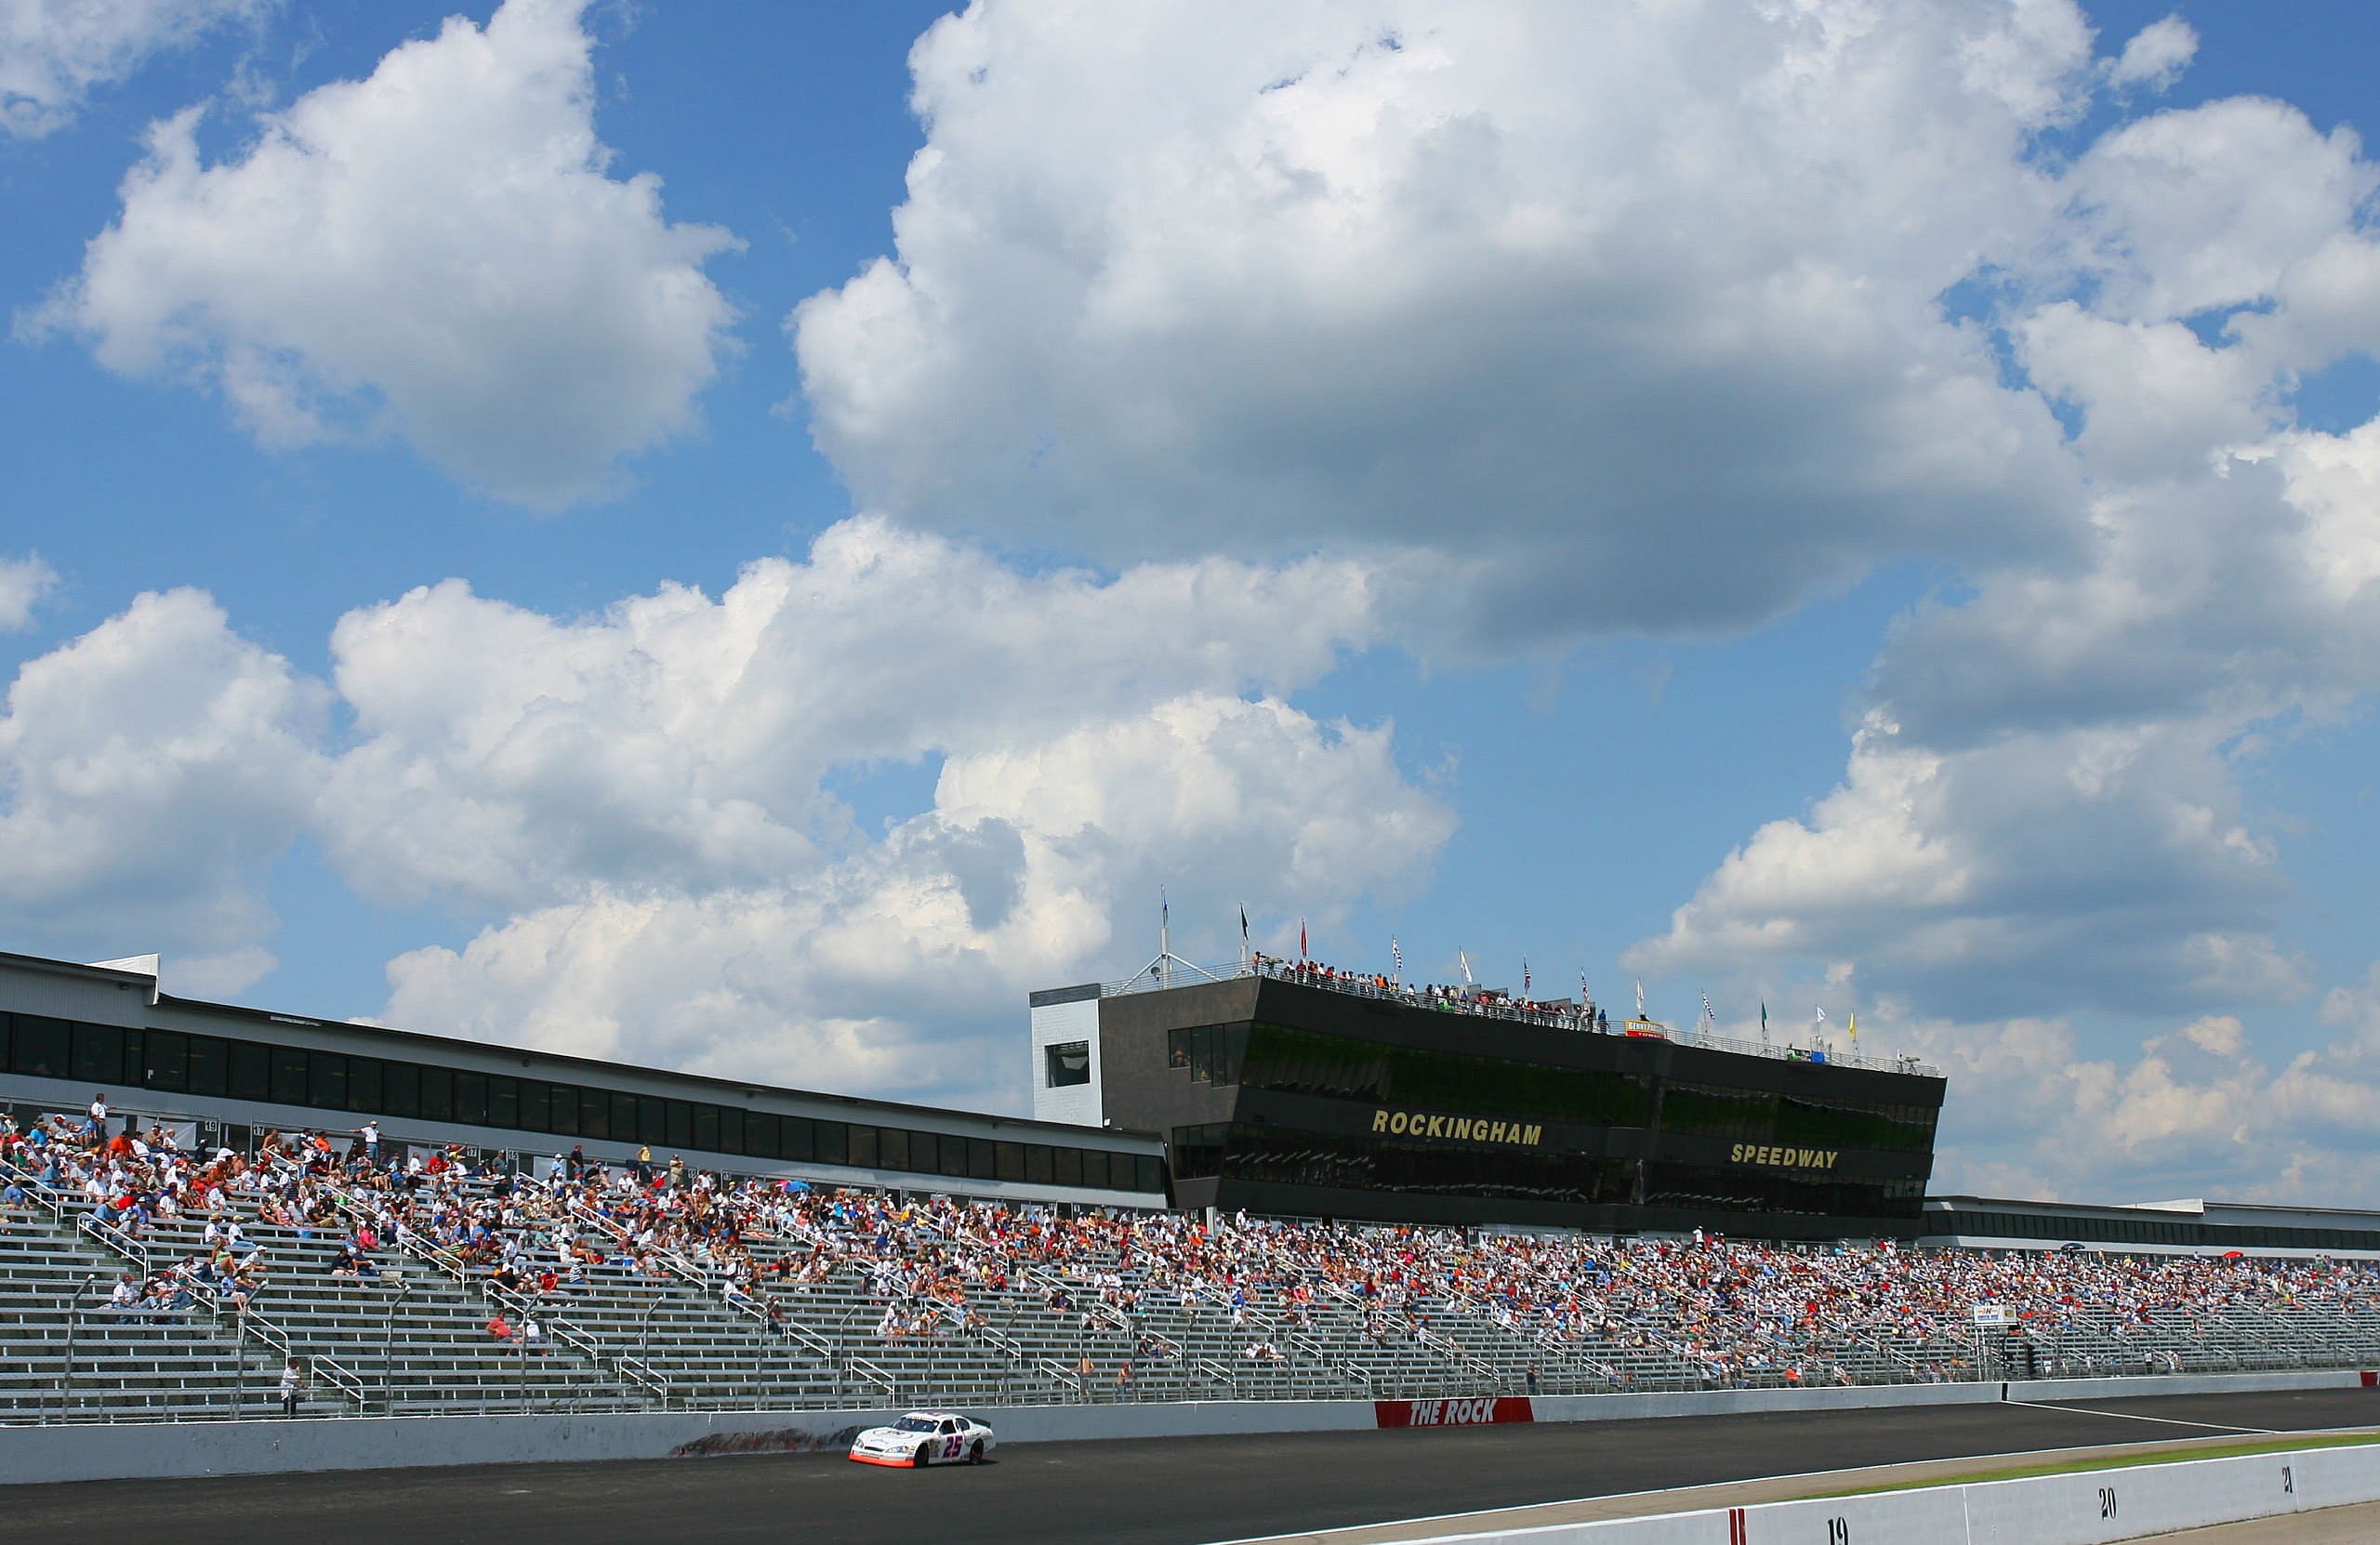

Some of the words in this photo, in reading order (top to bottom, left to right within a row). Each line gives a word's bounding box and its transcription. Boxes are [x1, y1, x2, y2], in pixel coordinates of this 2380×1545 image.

[205, 1121, 216, 1130] 19
[254, 1126, 264, 1135] 17
[1371, 1109, 1542, 1146] ROCKINGHAM
[1730, 1144, 1838, 1170] SPEEDWAY
[1409, 1400, 1442, 1426] THE
[1444, 1398, 1499, 1424] ROCK
[943, 1434, 963, 1459] 25
[2281, 1465, 2294, 1494] 21
[2098, 1486, 2117, 1522] 20
[1827, 1516, 1849, 1545] 19
